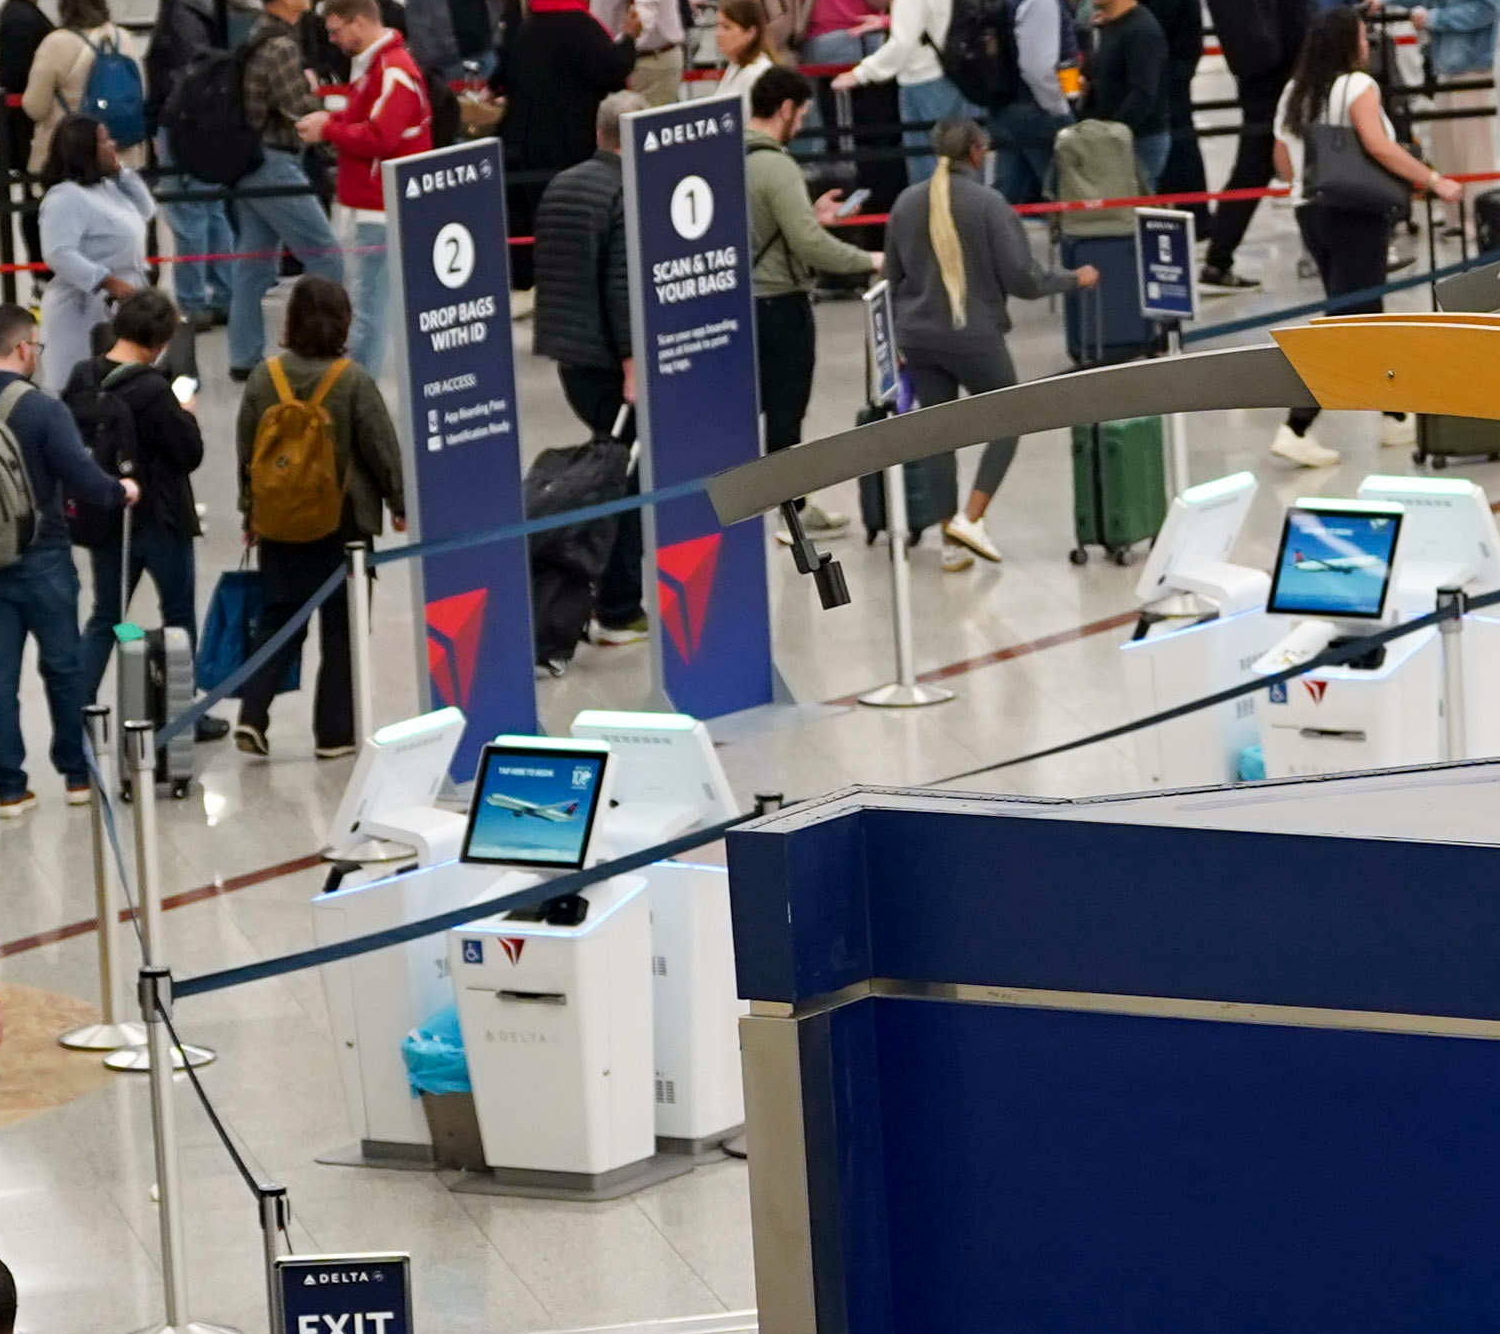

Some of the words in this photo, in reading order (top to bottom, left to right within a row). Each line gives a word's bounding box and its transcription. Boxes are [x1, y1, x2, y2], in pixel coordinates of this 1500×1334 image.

[660, 116, 719, 147] DELTA
[421, 163, 477, 192] DELTA
[685, 188, 697, 226] 1
[445, 236, 462, 275] 2
[652, 256, 692, 284] SCAN
[692, 253, 704, 273] &
[705, 246, 738, 270] TAG
[655, 276, 698, 306] YOUR
[698, 269, 738, 293] BAGS
[418, 302, 457, 333] DROP
[457, 295, 495, 323] BAGS
[430, 325, 469, 353] WITH
[469, 320, 488, 345] ID
[318, 1271, 370, 1285] DELTA
